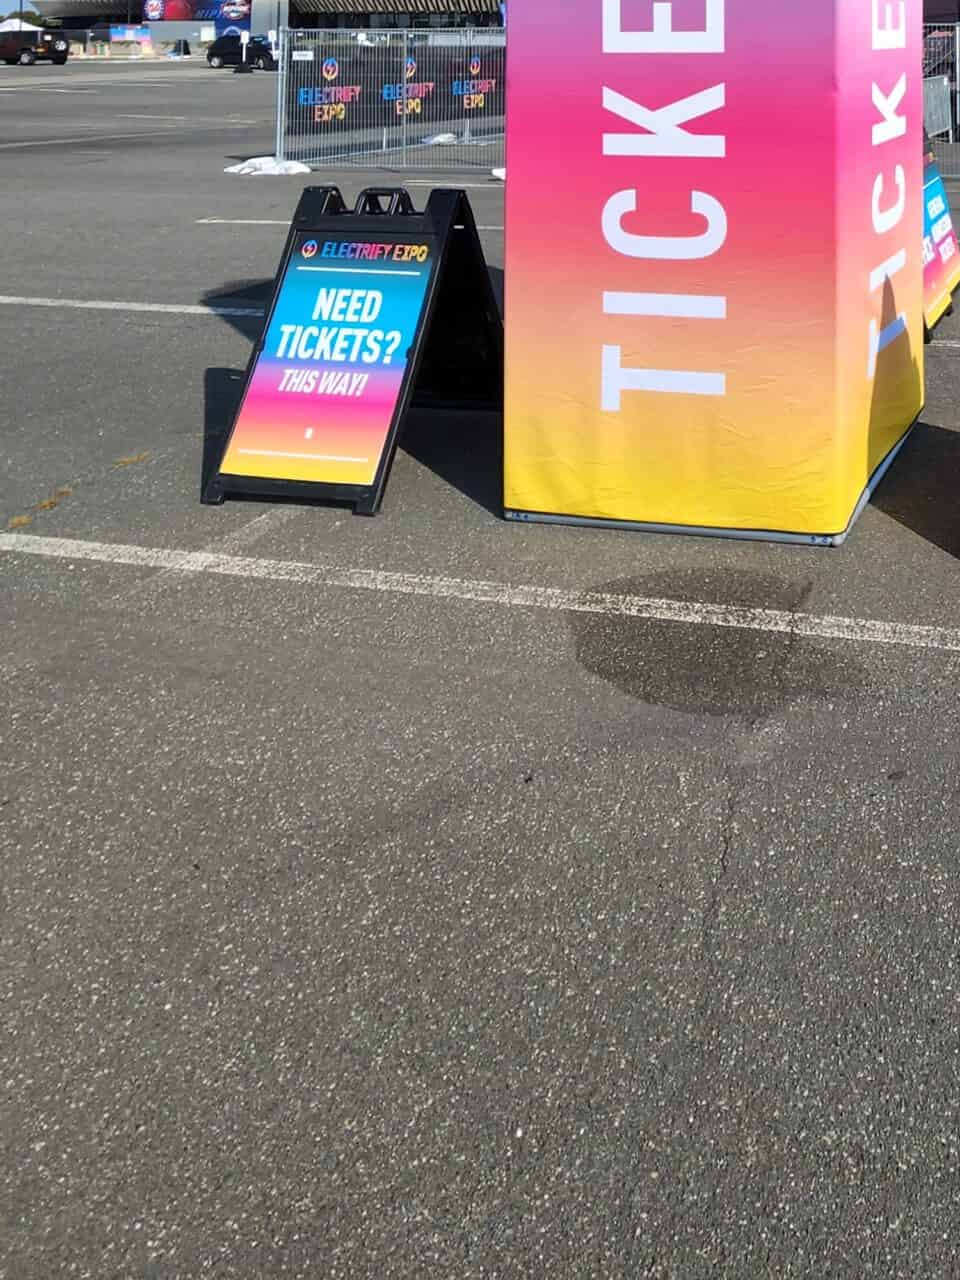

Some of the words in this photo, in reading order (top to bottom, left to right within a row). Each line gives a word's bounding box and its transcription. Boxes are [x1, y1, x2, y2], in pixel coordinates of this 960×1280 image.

[320, 240, 393, 261] ELECTRIFY
[391, 244, 429, 263] EXPO
[311, 287, 383, 324] NEED
[276, 323, 402, 365] TICKETS?
[277, 368, 320, 394] THIS
[317, 371, 369, 398] WAY!
